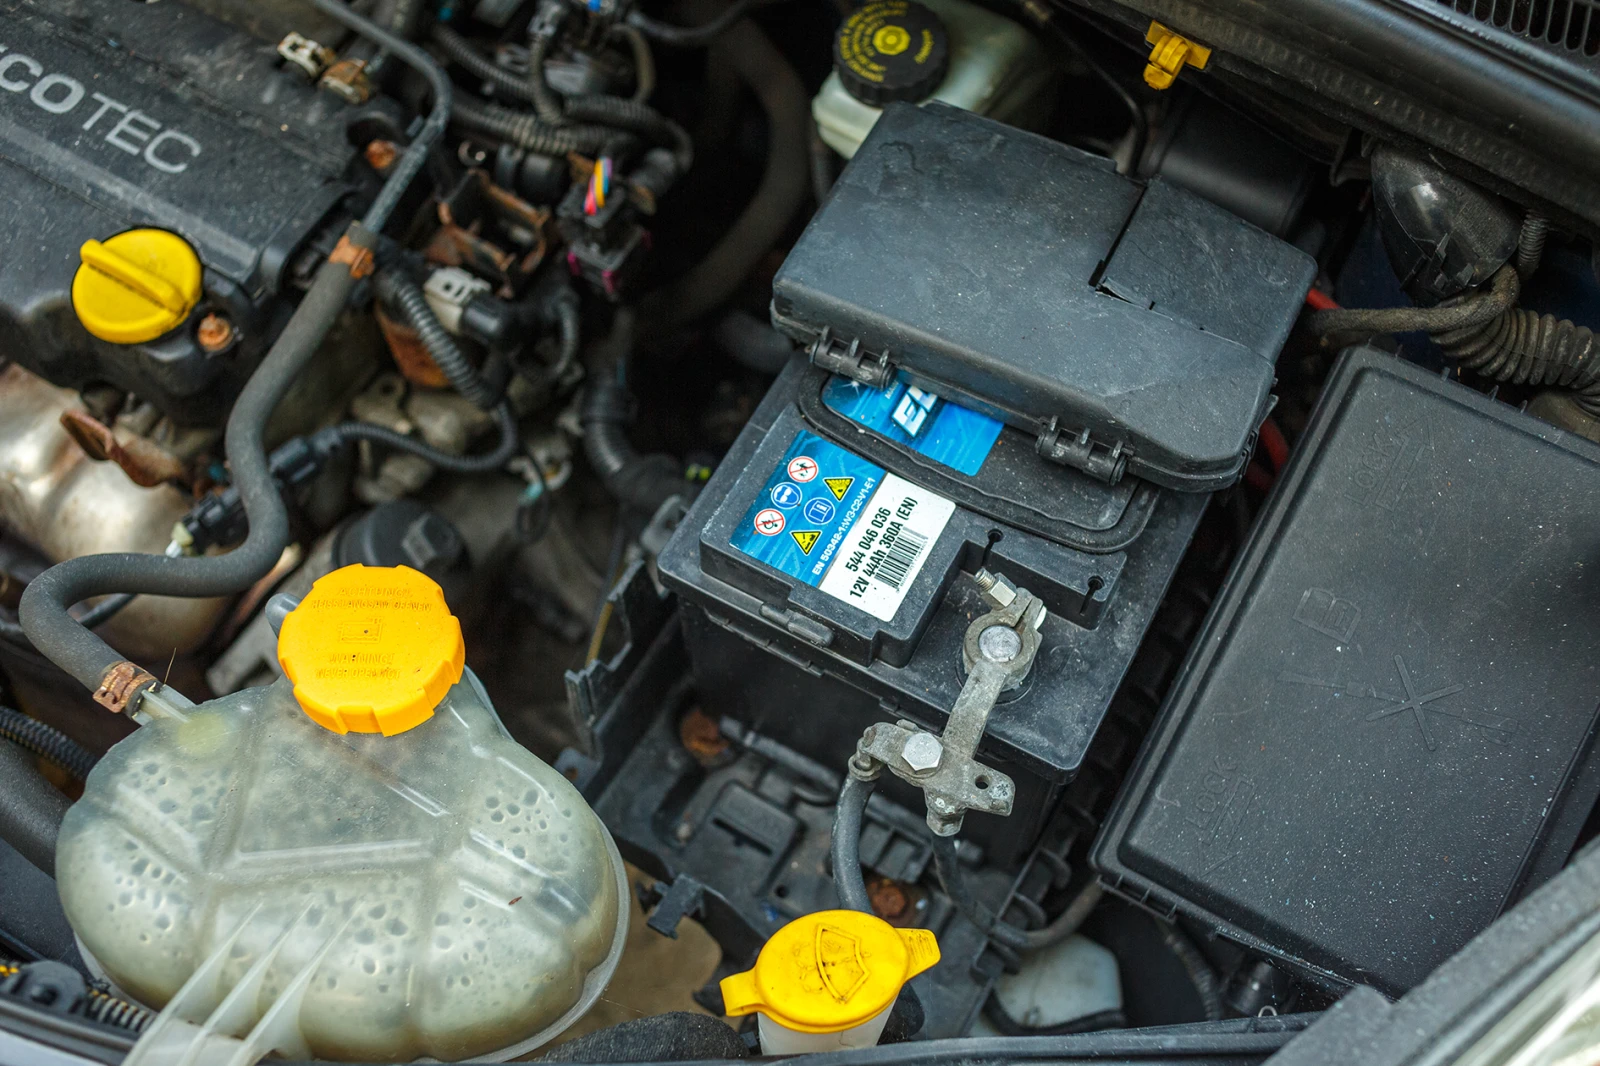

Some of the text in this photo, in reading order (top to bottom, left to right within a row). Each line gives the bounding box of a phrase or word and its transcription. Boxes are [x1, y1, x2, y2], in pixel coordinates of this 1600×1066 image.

[0, 44, 202, 173] COTEC
[811, 561, 825, 576] EN
[845, 507, 891, 572] 544 046 036
[849, 576, 870, 598] 12V
[862, 549, 887, 577] 44Ah
[878, 520, 903, 549] 360A
[895, 496, 918, 521] (EN)
[1184, 760, 1238, 830] LOCK
